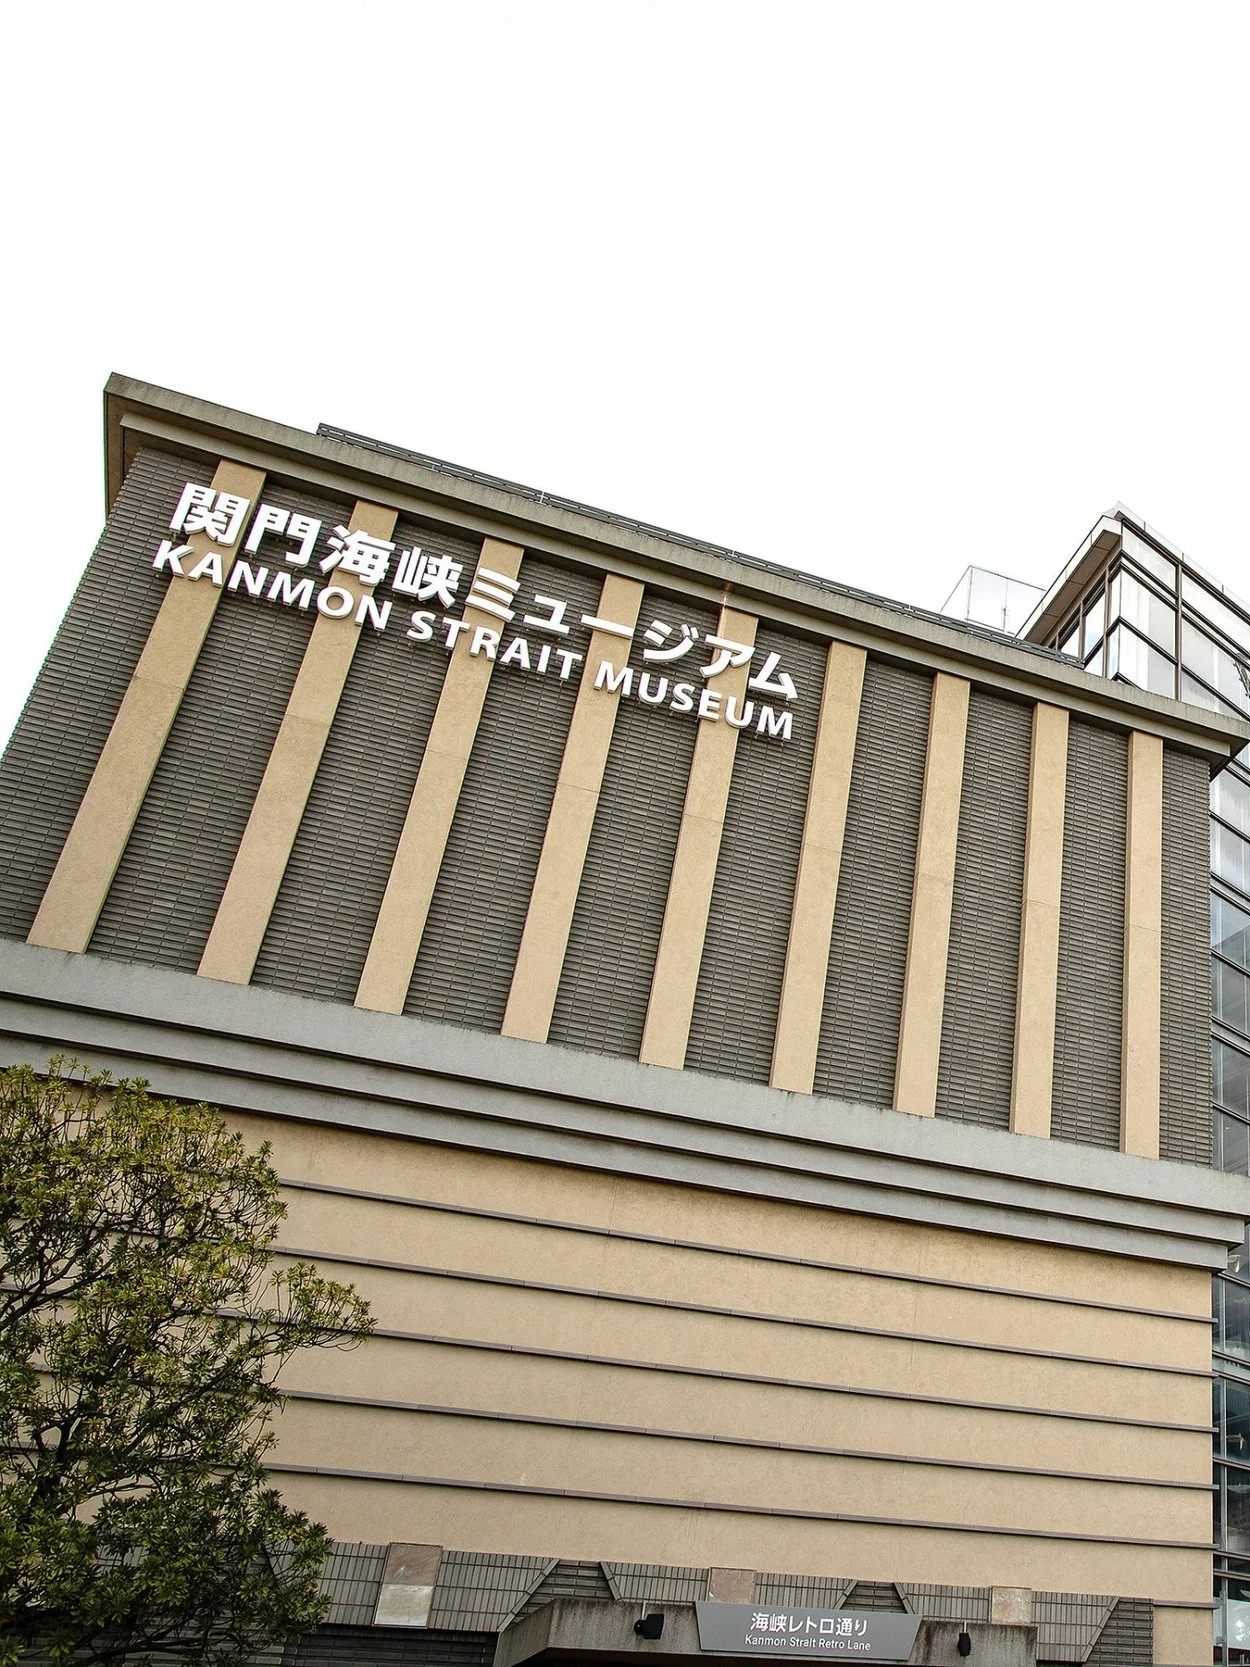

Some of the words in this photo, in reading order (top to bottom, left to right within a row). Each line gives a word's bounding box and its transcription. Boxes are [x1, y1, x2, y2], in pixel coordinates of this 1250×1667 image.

[152, 539, 393, 631] KANMON
[406, 610, 583, 690] STRAIT
[593, 660, 794, 740] MUSEUM
[168, 482, 799, 701] 関門海峡ミュージアム
[744, 1634, 787, 1647] Kanmon
[789, 1636, 817, 1648] Strait
[818, 1638, 845, 1650] Retro
[847, 1640, 871, 1651] Lane
[750, 1612, 868, 1637] 海峡レトロ通り
